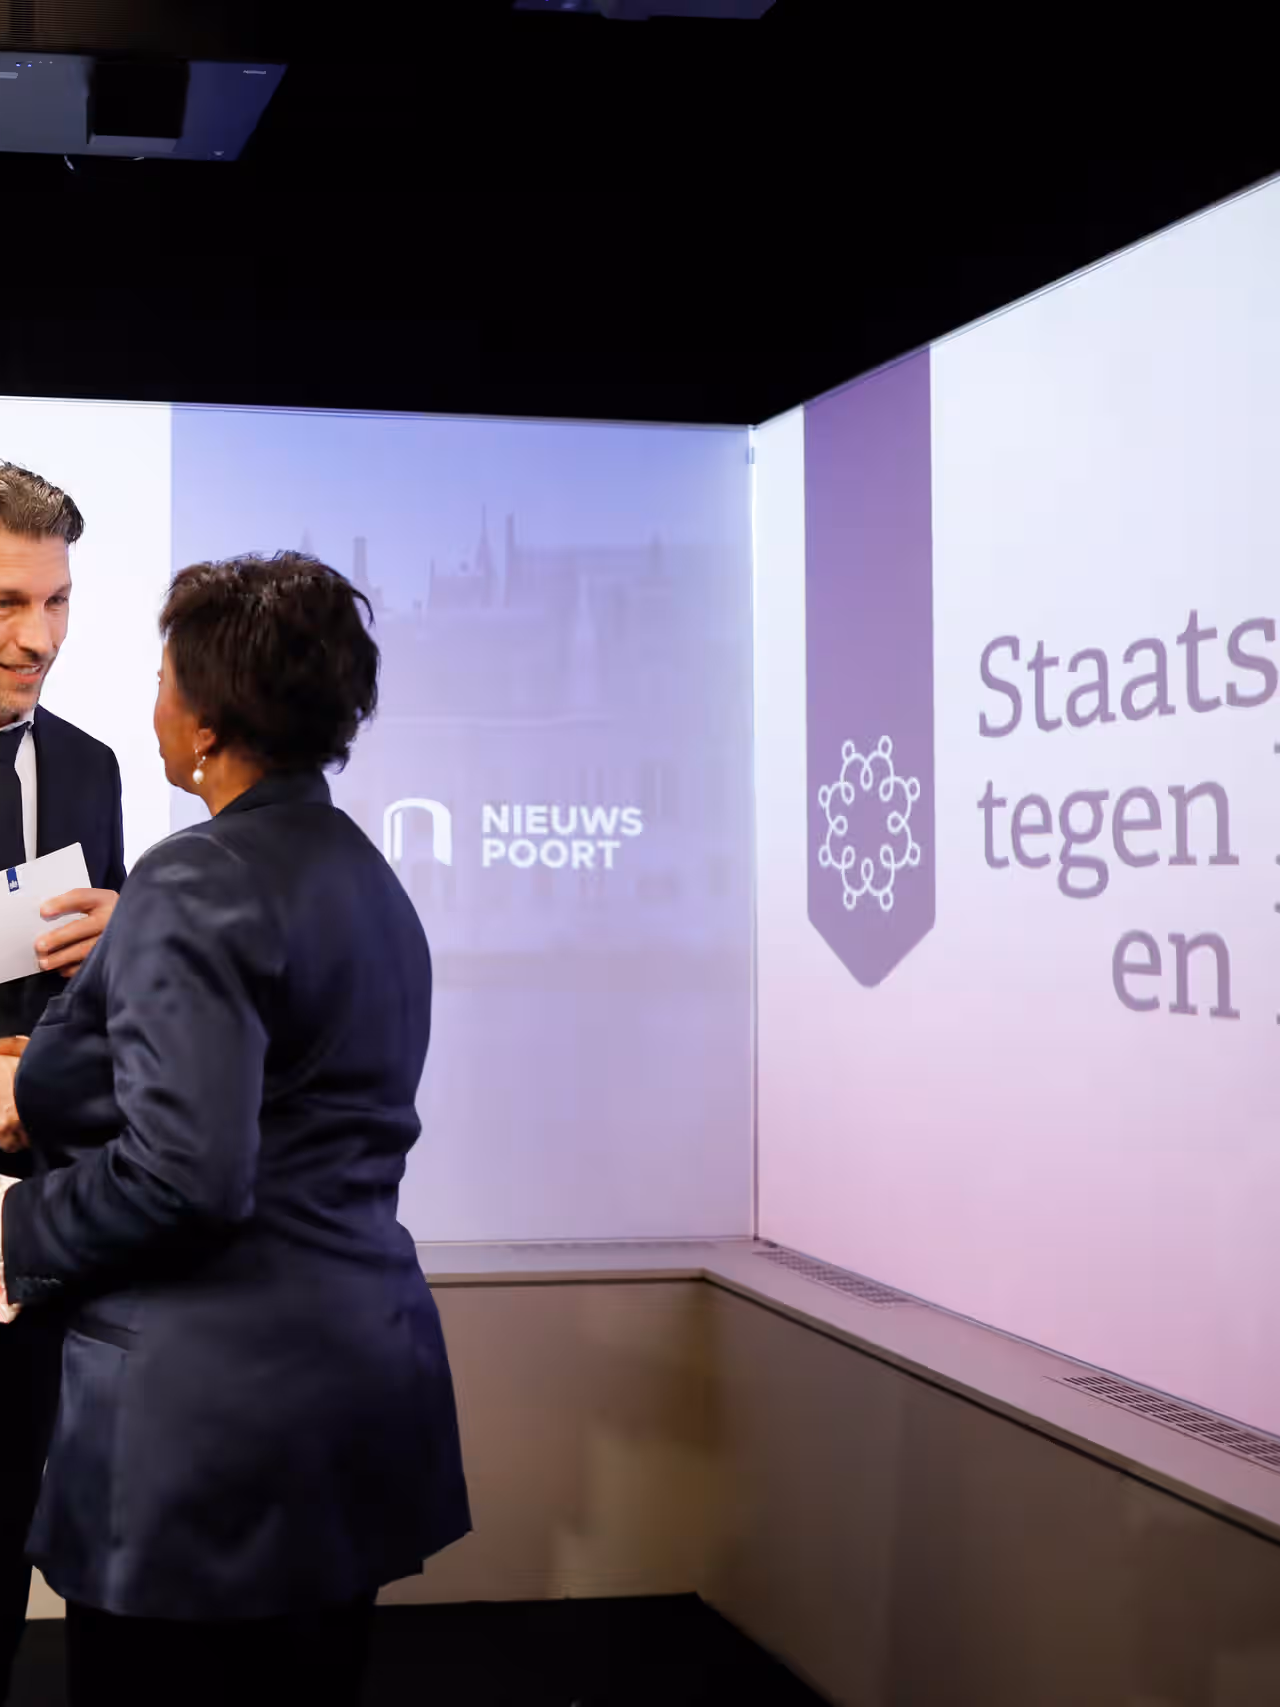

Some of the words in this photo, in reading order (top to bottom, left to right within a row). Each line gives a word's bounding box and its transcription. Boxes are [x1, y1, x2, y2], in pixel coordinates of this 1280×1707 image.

[978, 608, 1279, 738] Staats
[481, 803, 644, 837] NIEUWS
[481, 837, 622, 869] POORT
[977, 780, 1240, 899] tegen
[1112, 929, 1241, 1020] en
